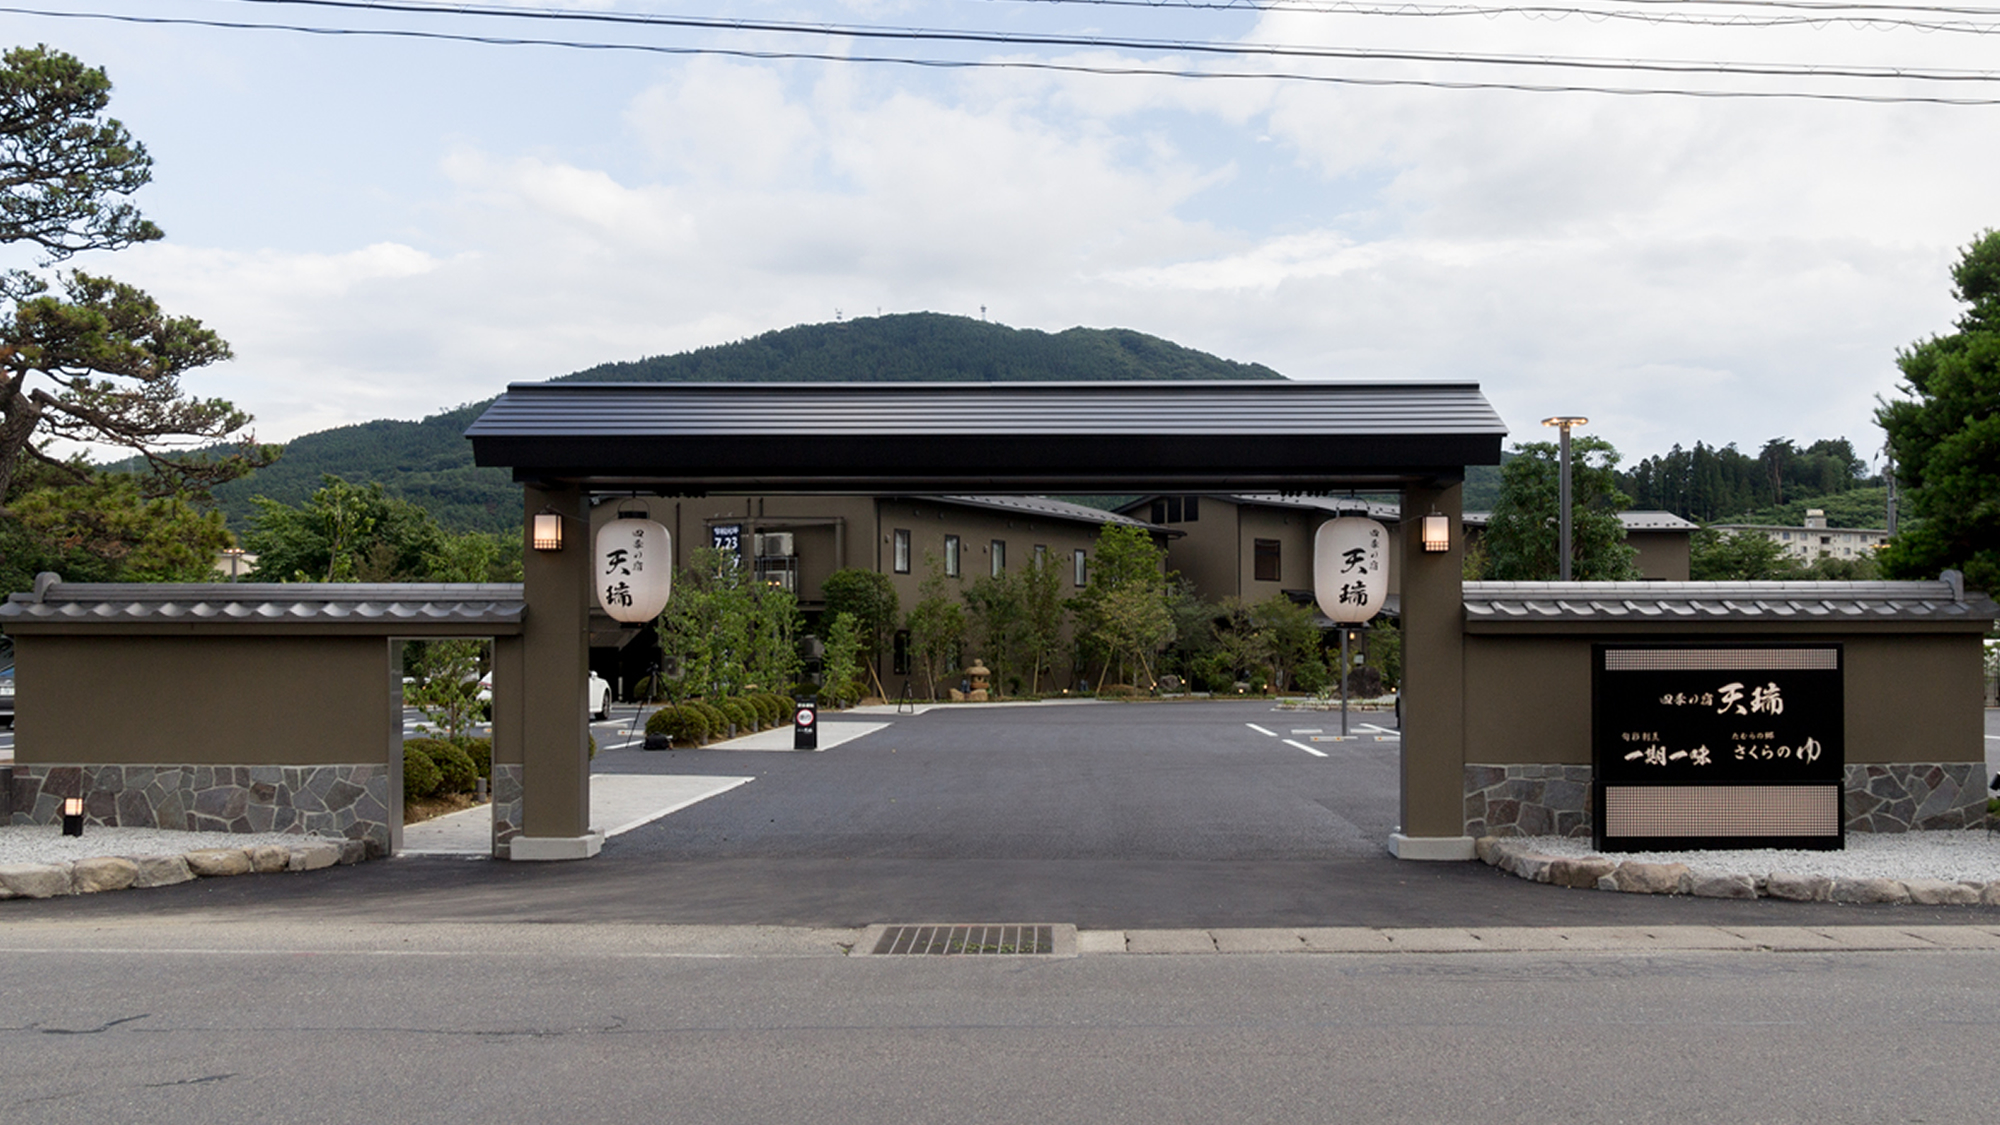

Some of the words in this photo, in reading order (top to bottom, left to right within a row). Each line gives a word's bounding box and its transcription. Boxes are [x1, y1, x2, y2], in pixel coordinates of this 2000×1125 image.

[606, 549, 632, 607] 天瑞
[1339, 548, 1368, 606] 天瑞
[1717, 682, 1783, 715] 天瑞
[1624, 744, 1711, 766] 一期一味
